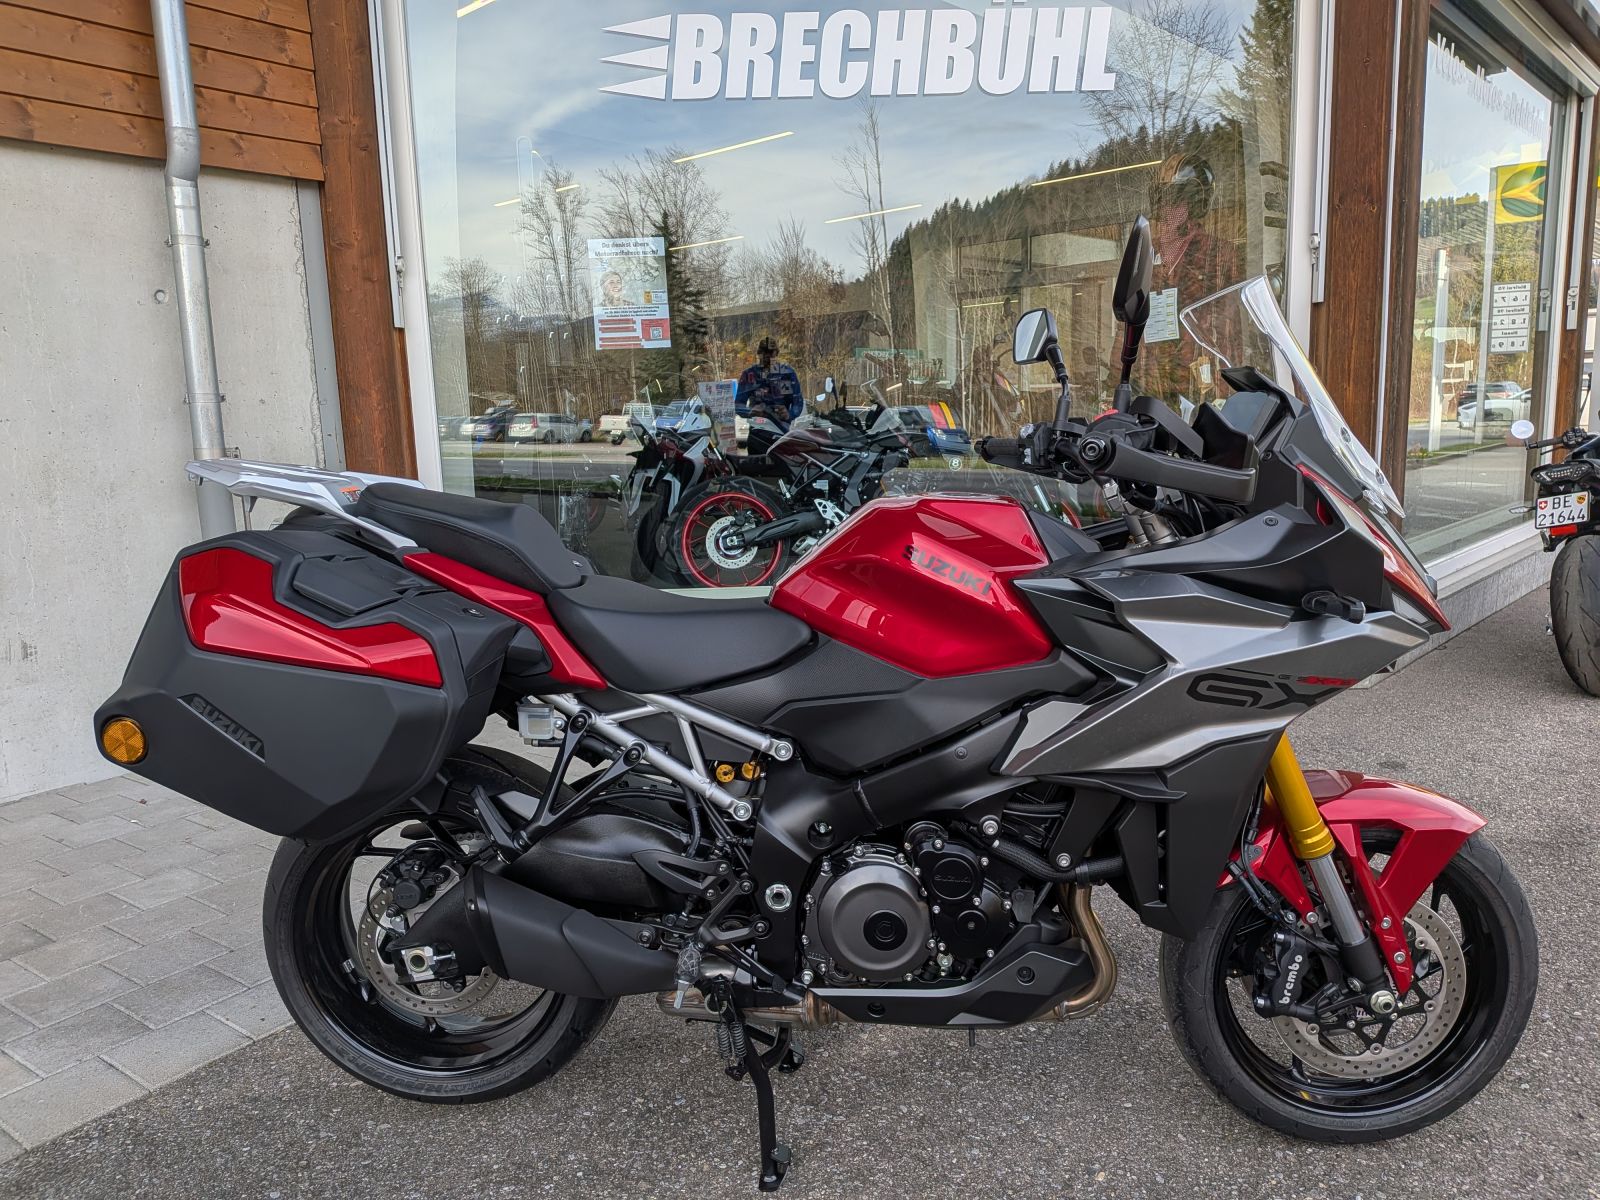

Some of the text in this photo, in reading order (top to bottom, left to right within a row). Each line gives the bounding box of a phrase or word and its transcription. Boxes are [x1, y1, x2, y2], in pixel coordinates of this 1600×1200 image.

[672, 0, 1116, 100] BRECHBÜHL
[1537, 508, 1586, 526] 21644
[1552, 495, 1573, 510] BE
[902, 544, 992, 596] SUZUKI
[190, 696, 262, 755] SUZUKI
[1278, 954, 1303, 1005] brembo
